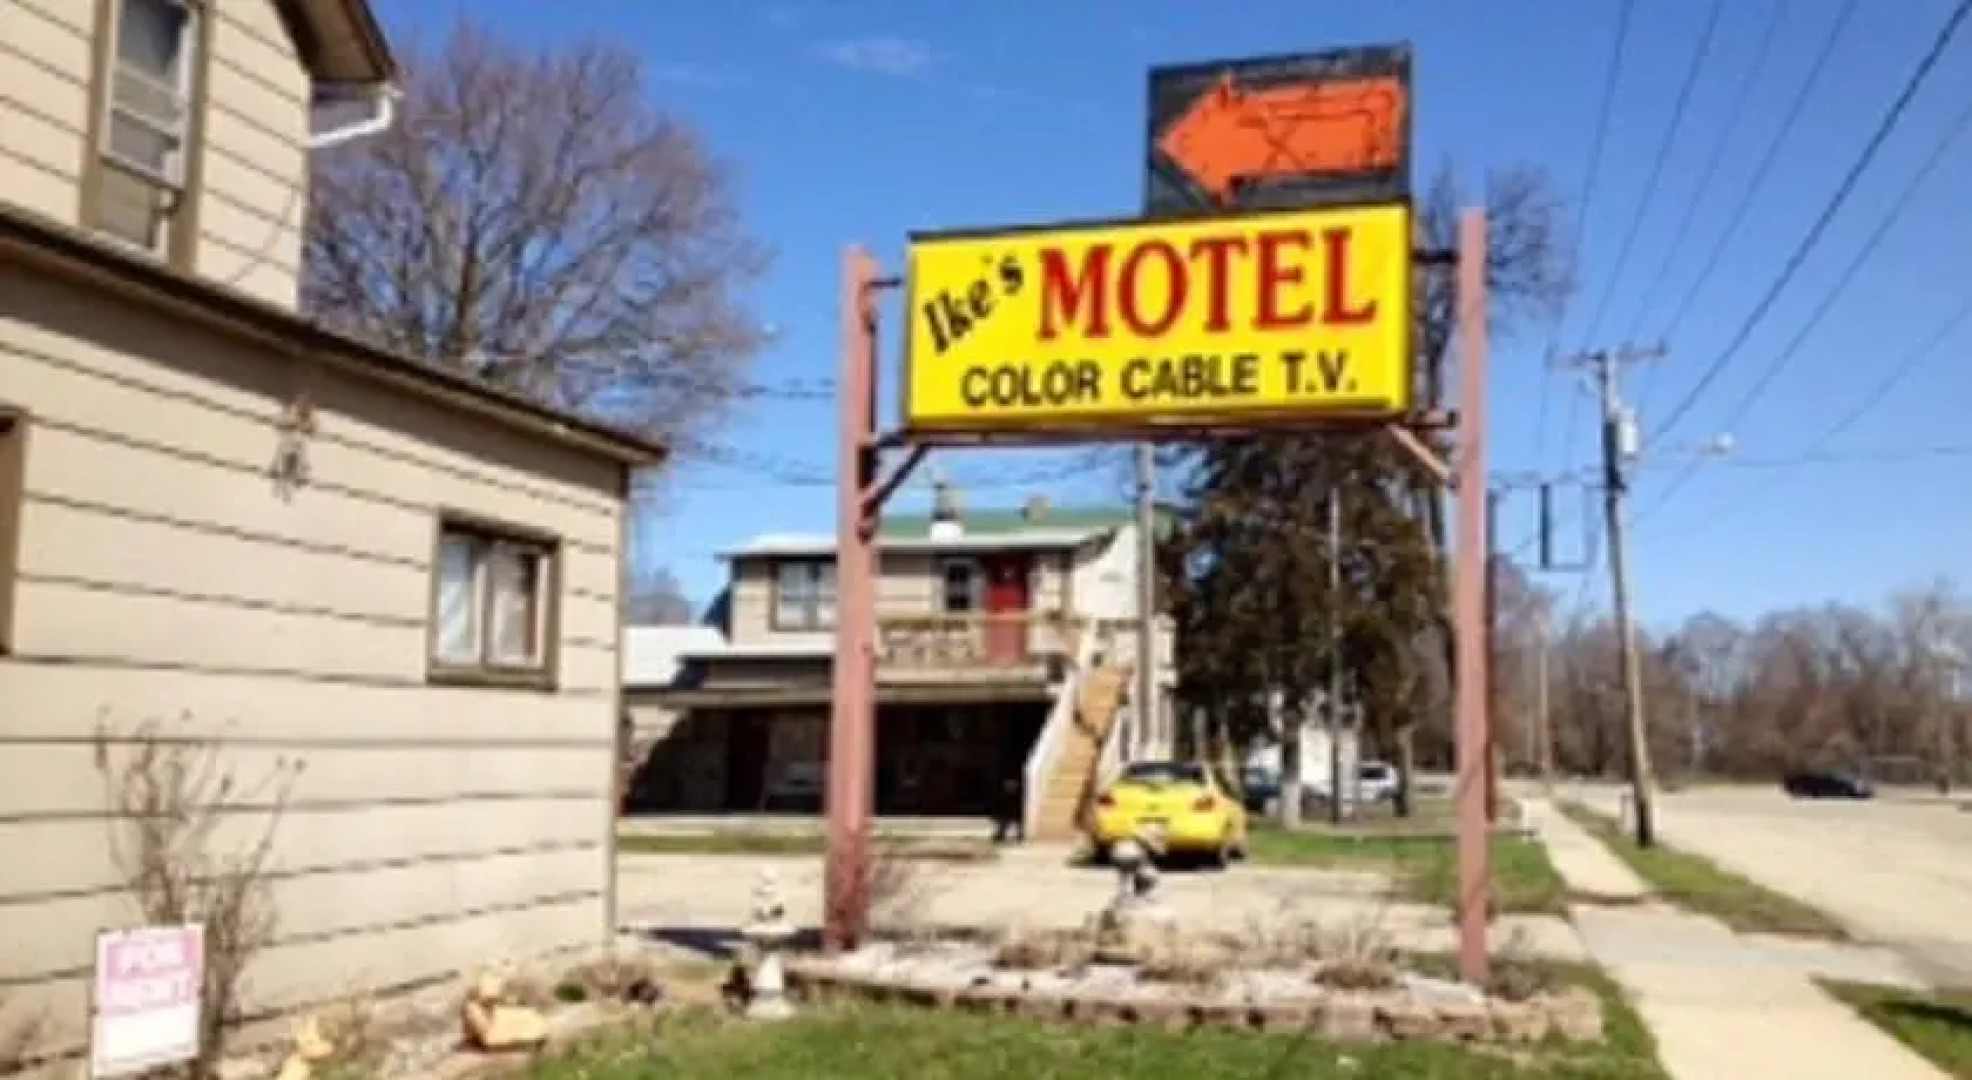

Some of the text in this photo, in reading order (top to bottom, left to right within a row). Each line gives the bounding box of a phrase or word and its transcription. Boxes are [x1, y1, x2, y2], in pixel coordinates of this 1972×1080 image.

[922, 227, 1378, 354] Ike's MOTEL
[961, 350, 1358, 407] COLOR CABLE T.V.
